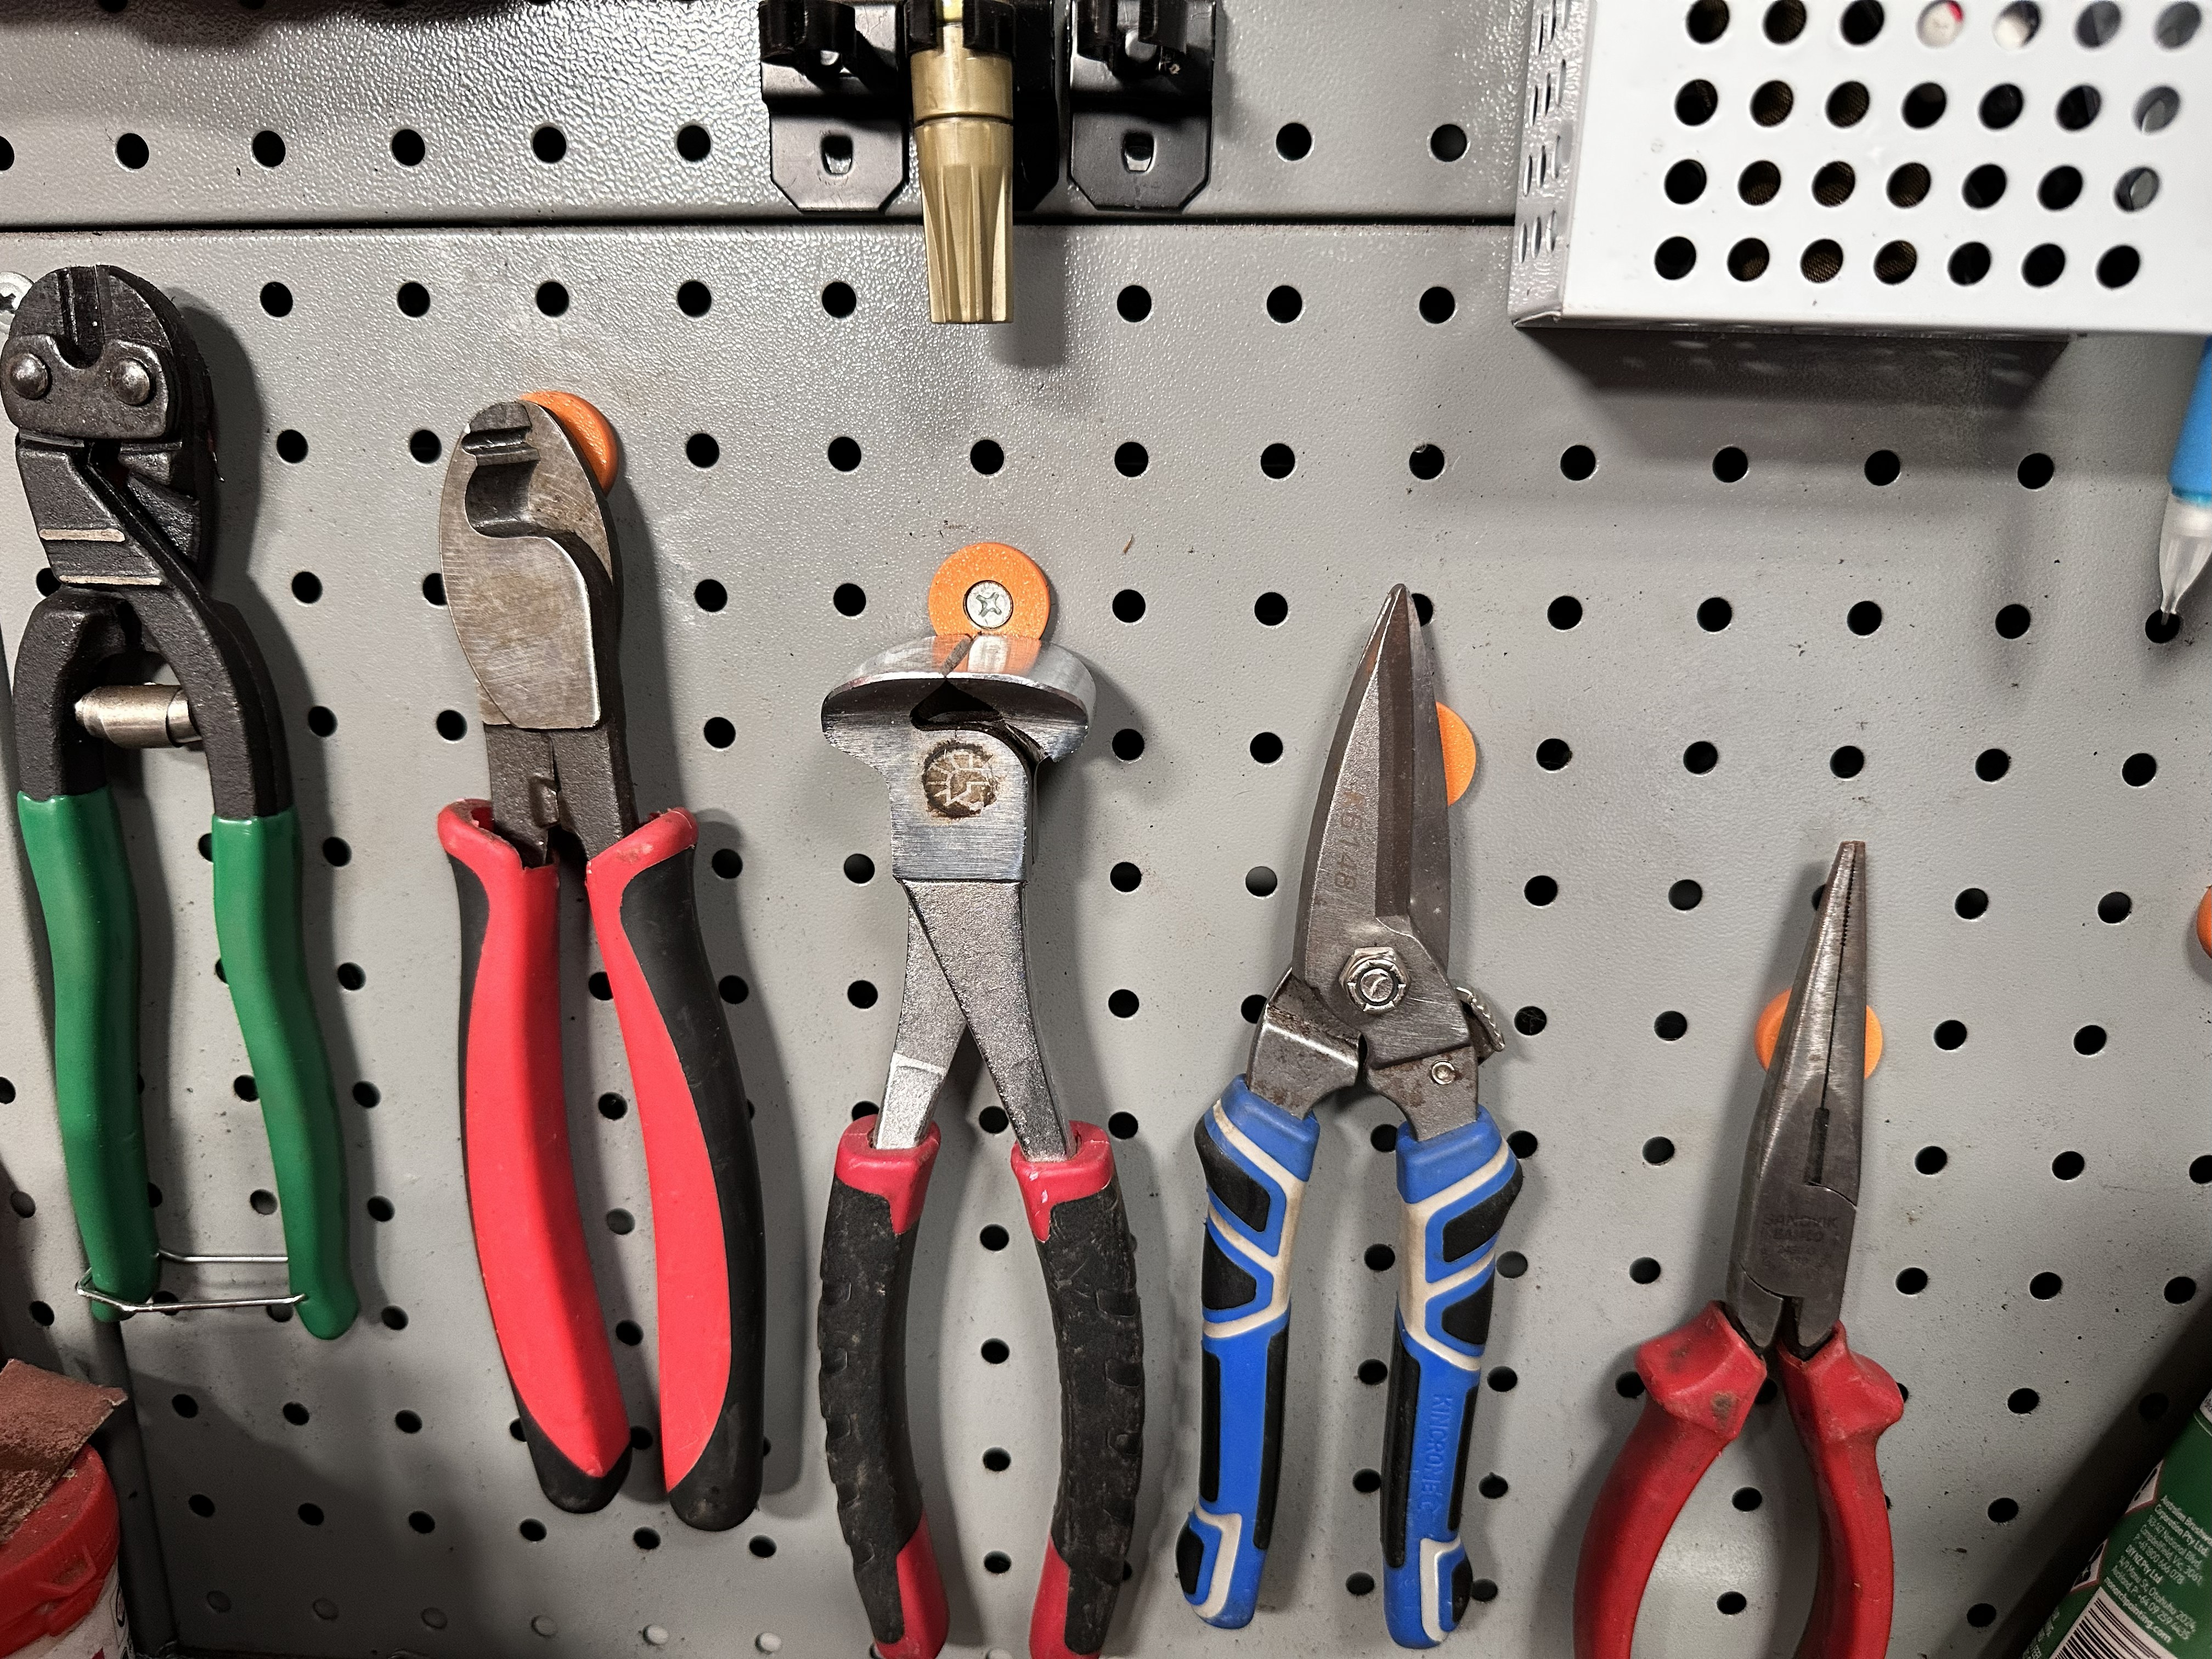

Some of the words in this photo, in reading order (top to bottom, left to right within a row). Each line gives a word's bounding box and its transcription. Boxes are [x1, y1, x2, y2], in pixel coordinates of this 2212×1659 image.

[2182, 1531, 2196, 1545] Pty
[2140, 1560, 2151, 1574] Pty
[2158, 1559, 2171, 1573] 666
[2170, 1570, 2185, 1584] 078
